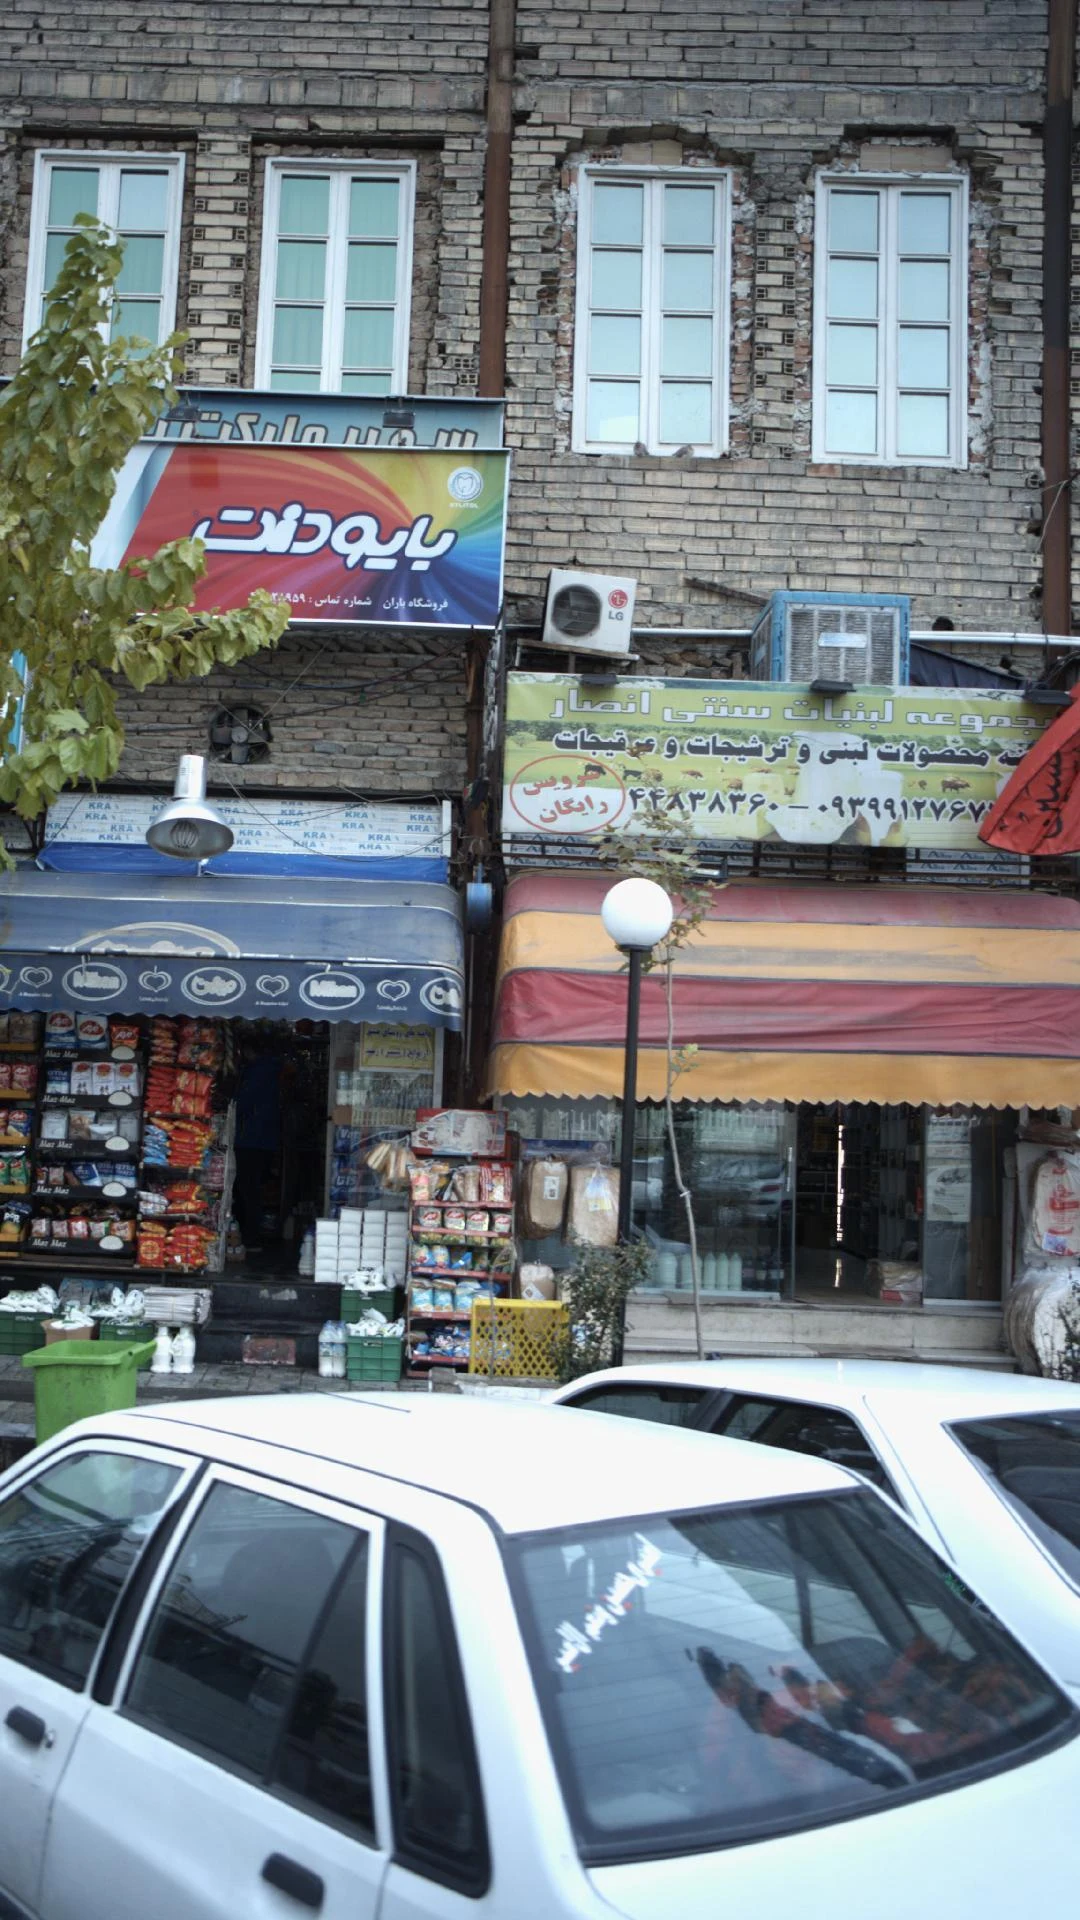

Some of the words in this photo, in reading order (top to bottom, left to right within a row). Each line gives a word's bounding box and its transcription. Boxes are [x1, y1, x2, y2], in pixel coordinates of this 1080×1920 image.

[190, 500, 460, 571] بایودنت
[314, 594, 341, 607] تماس
[343, 596, 373, 607] شماره
[383, 598, 406, 610] باران
[408, 597, 449, 612] فروشگاه
[608, 611, 624, 621] LG
[549, 687, 650, 718] انصار
[663, 696, 772, 724] سنتی
[784, 698, 893, 730] لبنیات
[905, 713, 1048, 734] جموعه
[663, 735, 680, 760] و
[686, 733, 791, 764] ترشیجات
[818, 740, 870, 766] لبنی
[876, 738, 990, 769] محصولات
[539, 795, 610, 824] رایگان
[816, 794, 994, 824] ۰۹۳۹۹۱۲۷۶۷
